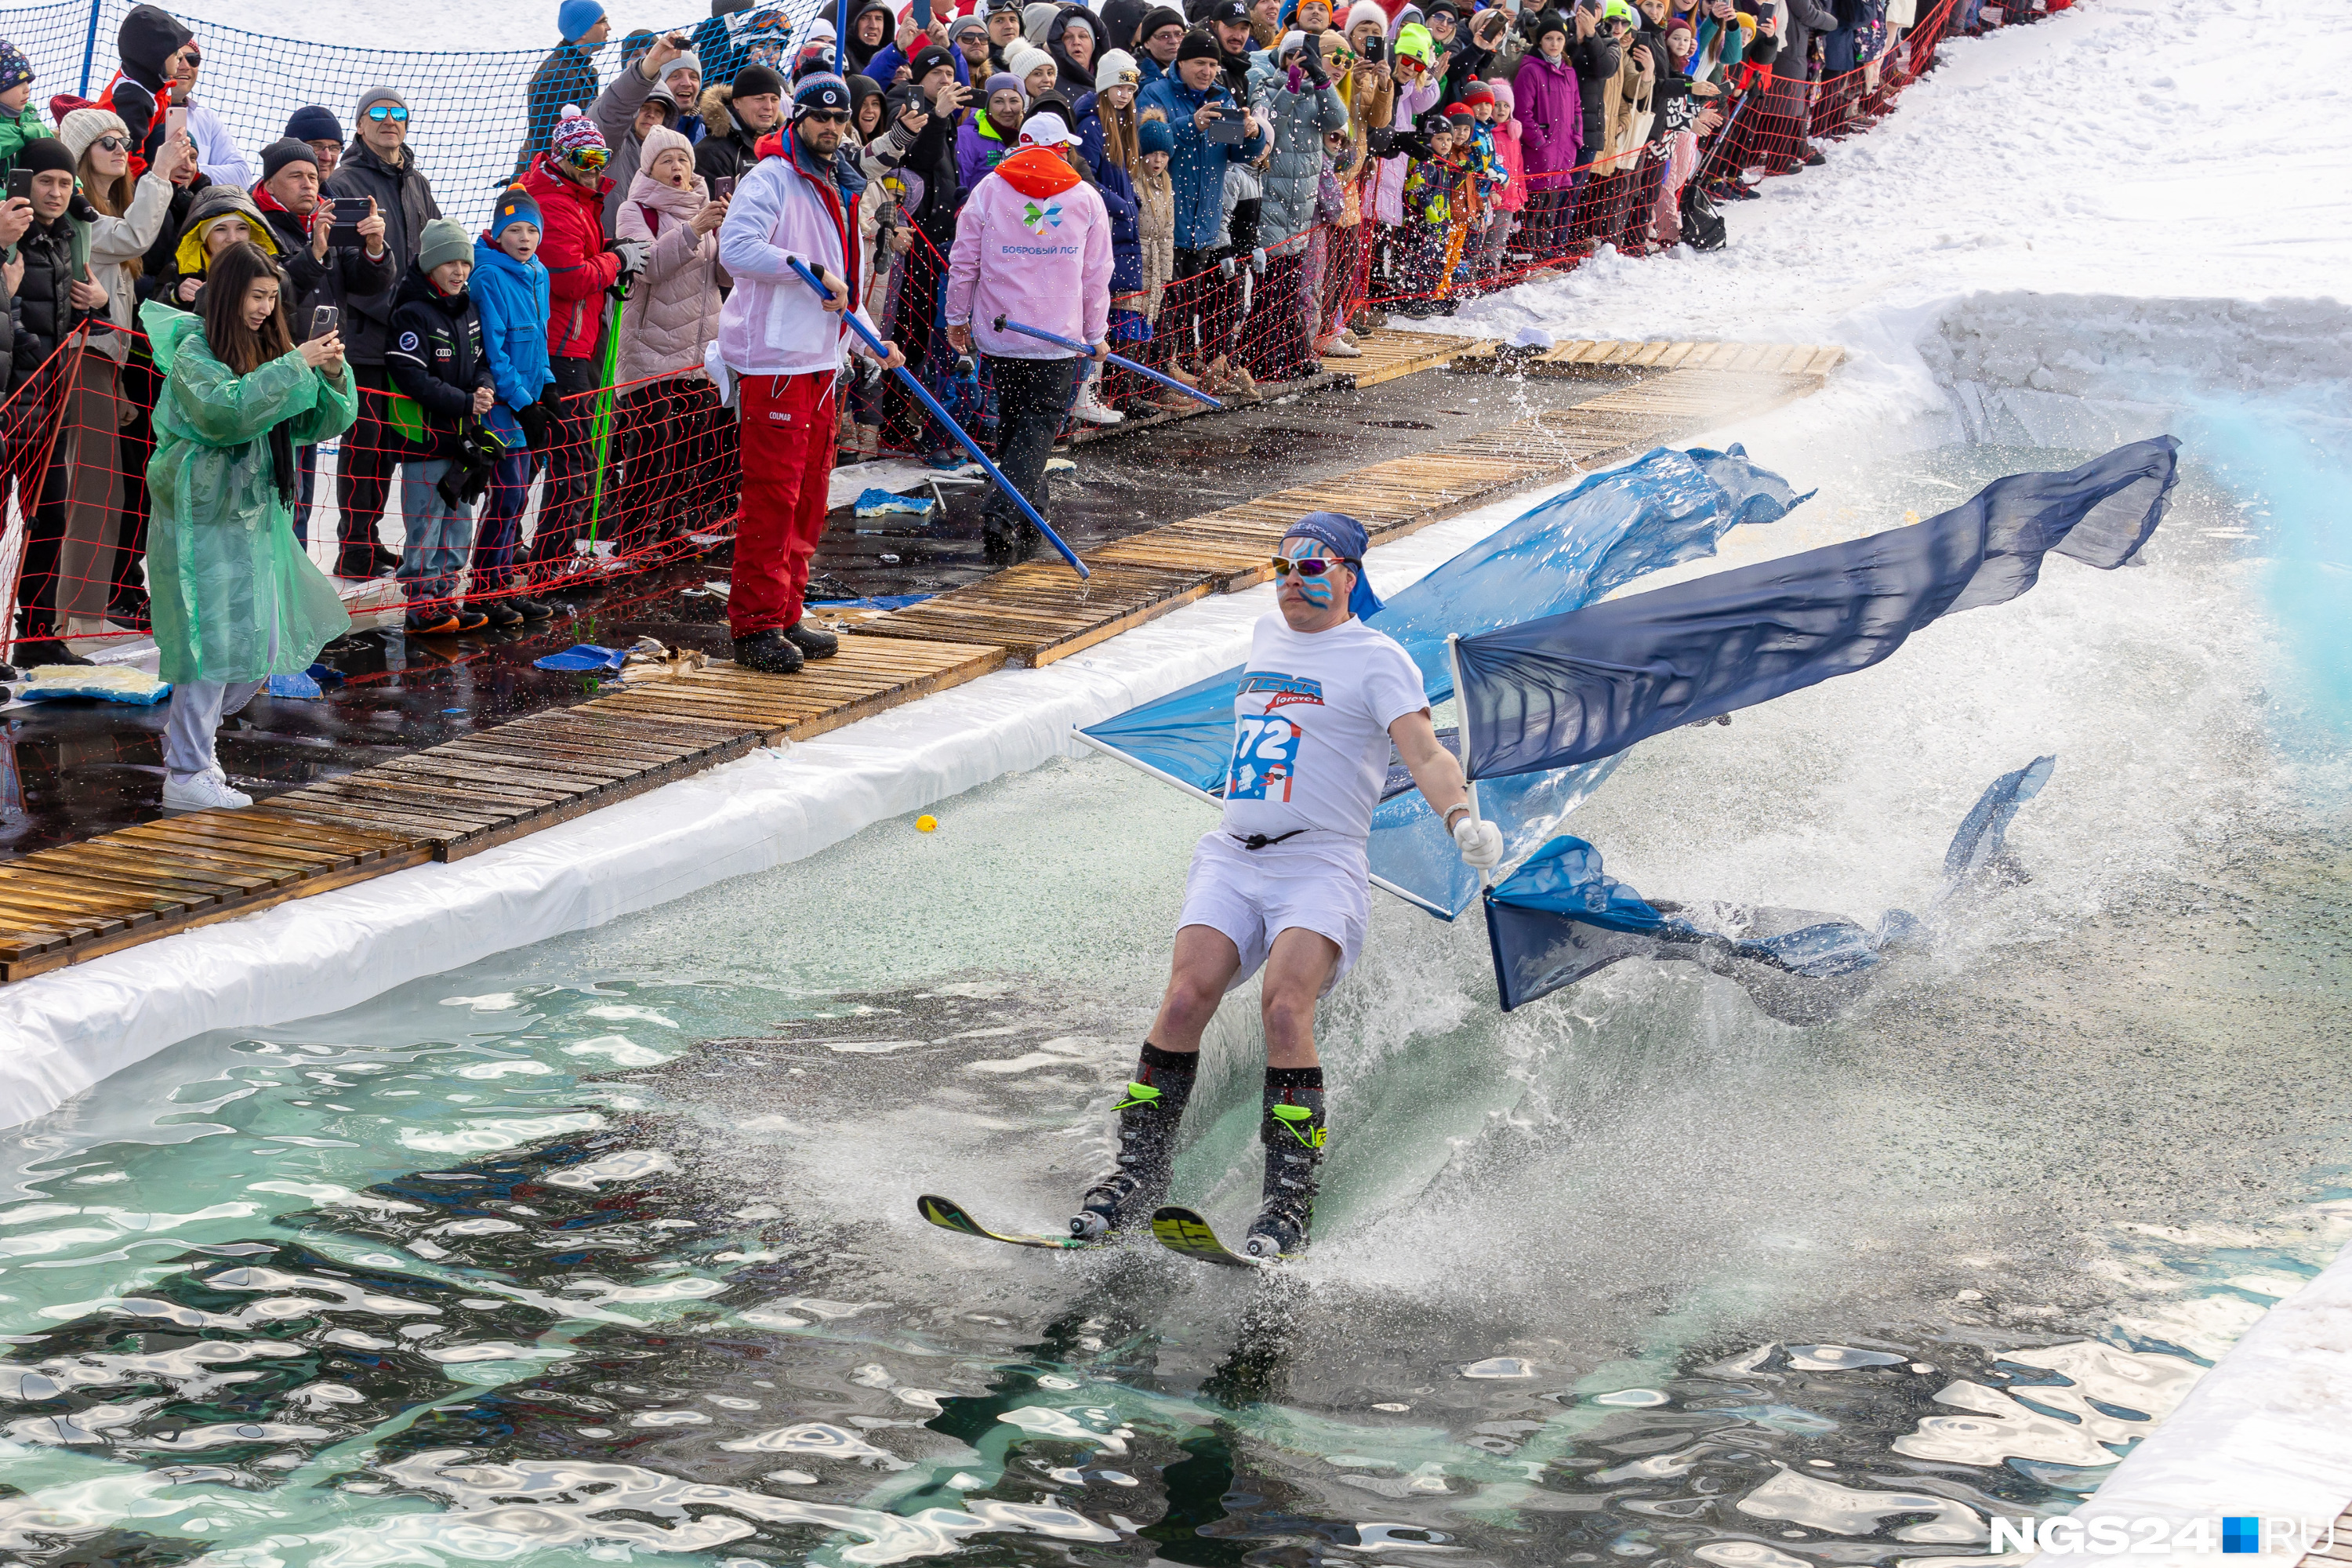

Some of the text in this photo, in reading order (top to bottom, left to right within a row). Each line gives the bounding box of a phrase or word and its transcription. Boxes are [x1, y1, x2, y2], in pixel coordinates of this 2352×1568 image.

[1002, 245, 1057, 255] БОБРОВЫЙ
[769, 411, 791, 422] COLMAR
[1276, 696, 1319, 705] forever
[1240, 719, 1292, 760] 72
